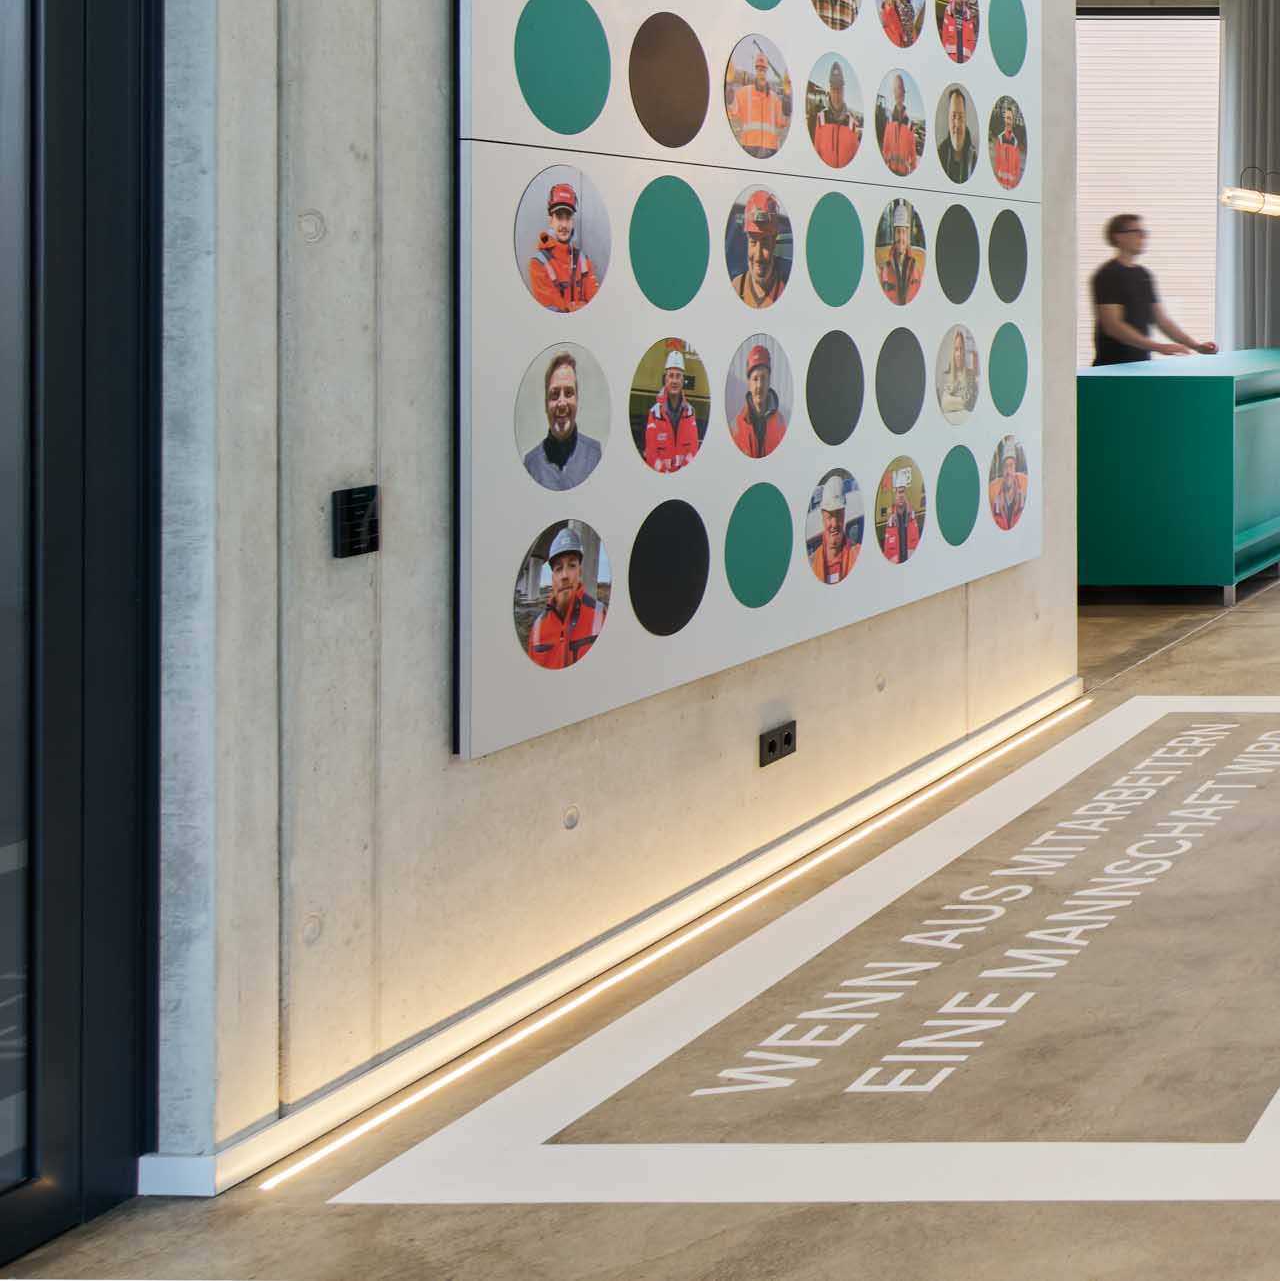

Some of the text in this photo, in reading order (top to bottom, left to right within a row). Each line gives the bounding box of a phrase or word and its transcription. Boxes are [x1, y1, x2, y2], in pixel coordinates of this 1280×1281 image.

[691, 723, 1240, 1096] WENN AUS MITARBEITERN
[844, 991, 1035, 1094] EINE
[978, 780, 1256, 978] MANNSCHAFT
